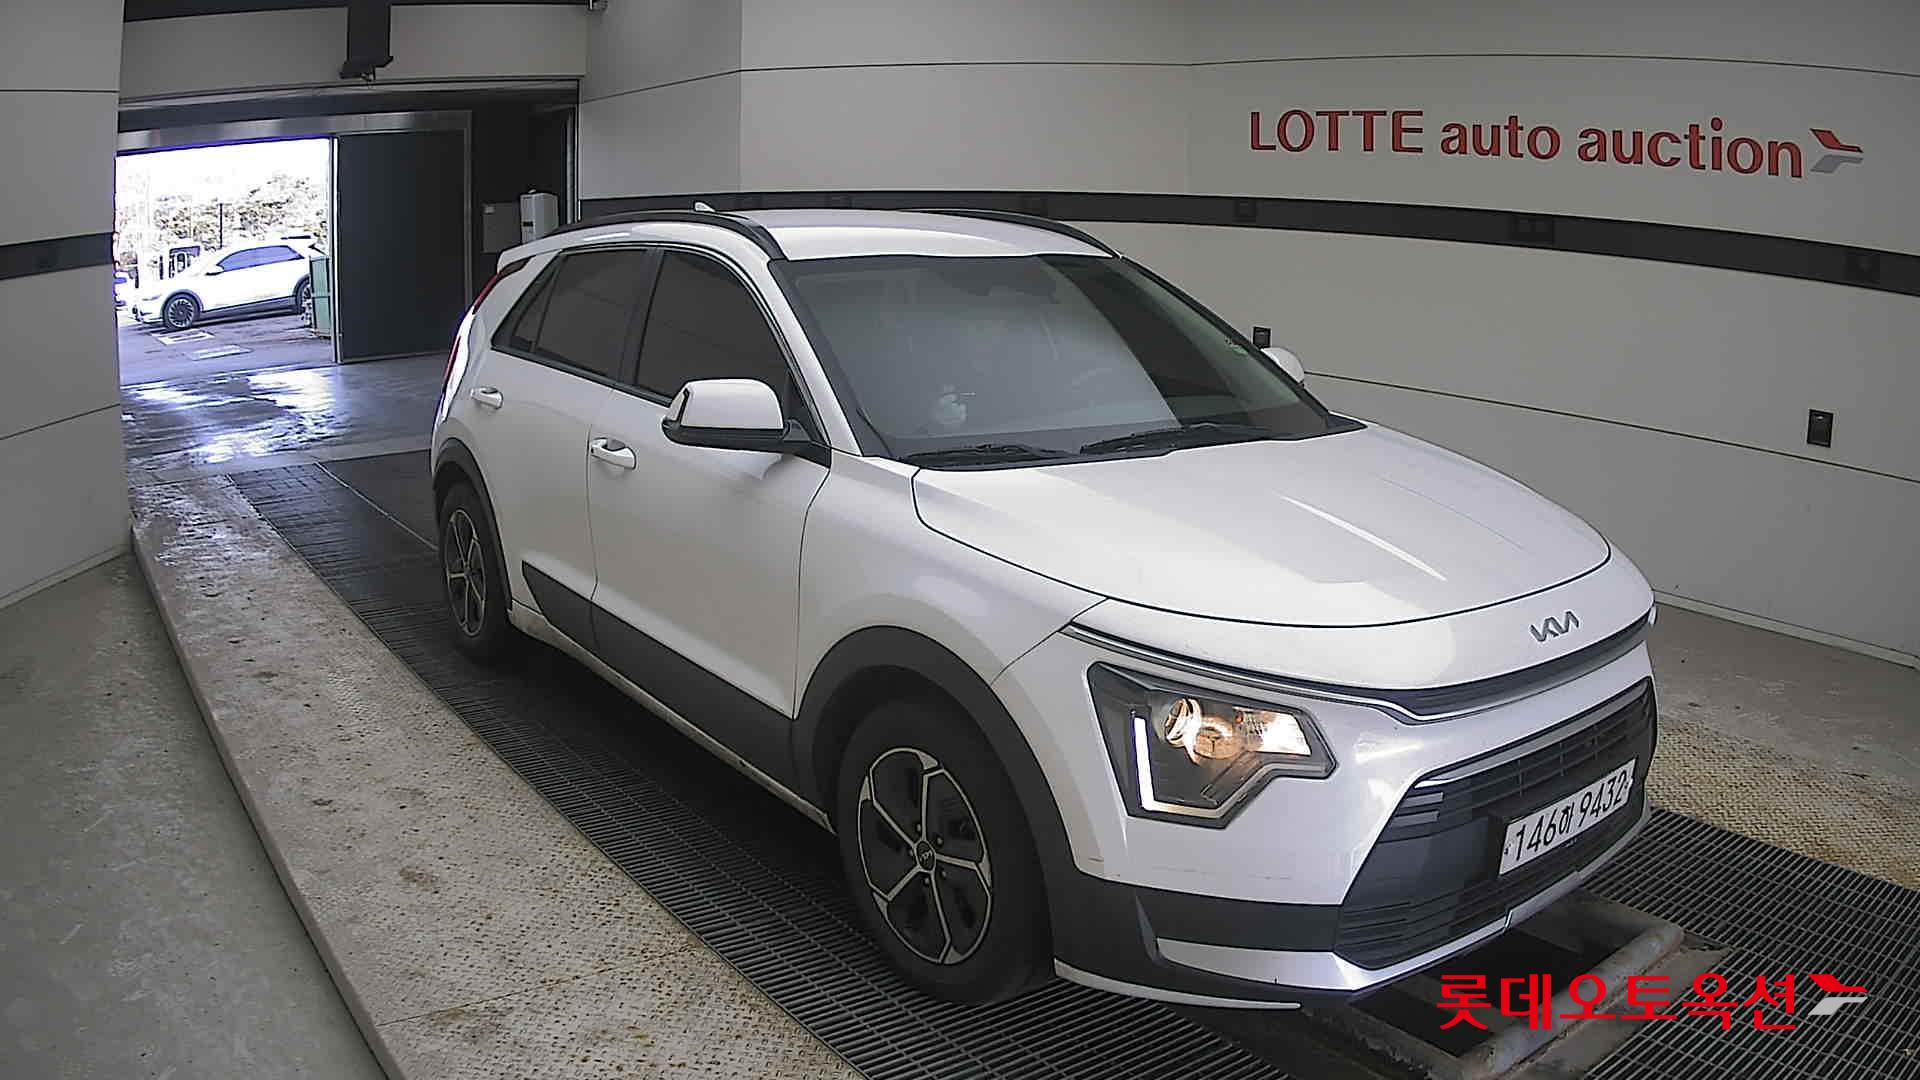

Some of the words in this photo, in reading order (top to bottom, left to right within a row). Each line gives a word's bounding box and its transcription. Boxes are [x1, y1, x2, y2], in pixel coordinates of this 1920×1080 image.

[1250, 110, 1424, 153] LOTTE
[1440, 115, 1561, 161] auto
[1577, 116, 1803, 179] auction
[1578, 769, 1628, 828] 9432
